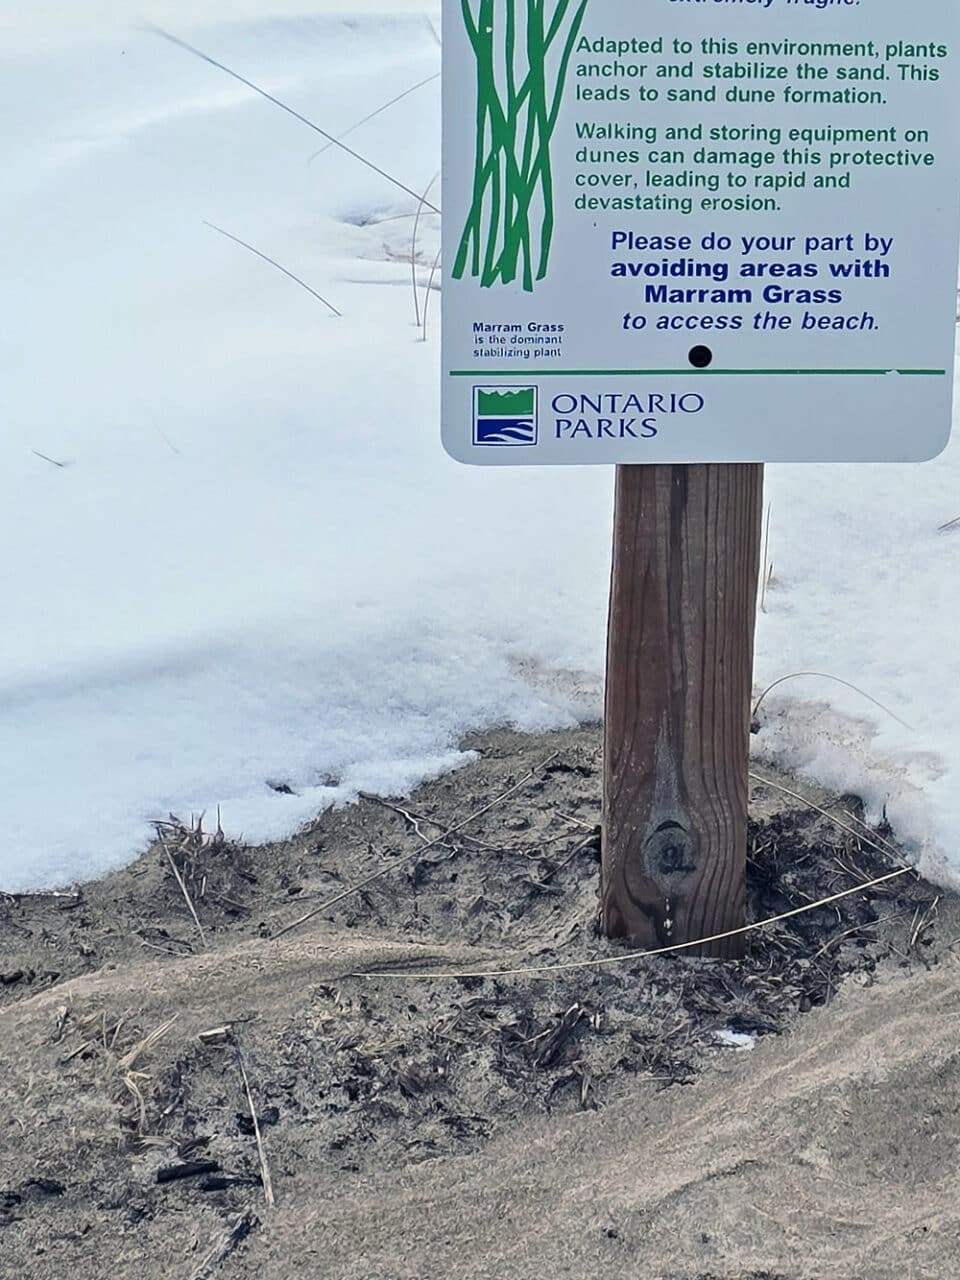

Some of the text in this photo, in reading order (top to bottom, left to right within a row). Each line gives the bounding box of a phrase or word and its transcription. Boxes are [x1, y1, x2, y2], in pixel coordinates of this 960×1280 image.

[576, 36, 947, 61] Adapted to this environment, plants
[577, 61, 939, 81] anchor and stabilize the sand. This
[577, 84, 886, 104] leads to sand dune formation.
[576, 123, 928, 145] Walking and storing equipment on
[576, 147, 934, 168] dunes can damage this protective
[576, 170, 850, 191] cover, leading to rapid and
[575, 194, 780, 214] devastating erosion.
[612, 232, 893, 256] Please do your part by
[611, 258, 889, 281] avoiding areas with
[646, 285, 842, 303] Marram Grass
[473, 322, 564, 332] Marram Grass
[623, 311, 878, 329] to access the beach.
[475, 335, 561, 344] is the dominant
[474, 348, 560, 359] stabilizing plant
[552, 394, 704, 414] ONTARIO
[556, 418, 657, 438] PARKS
